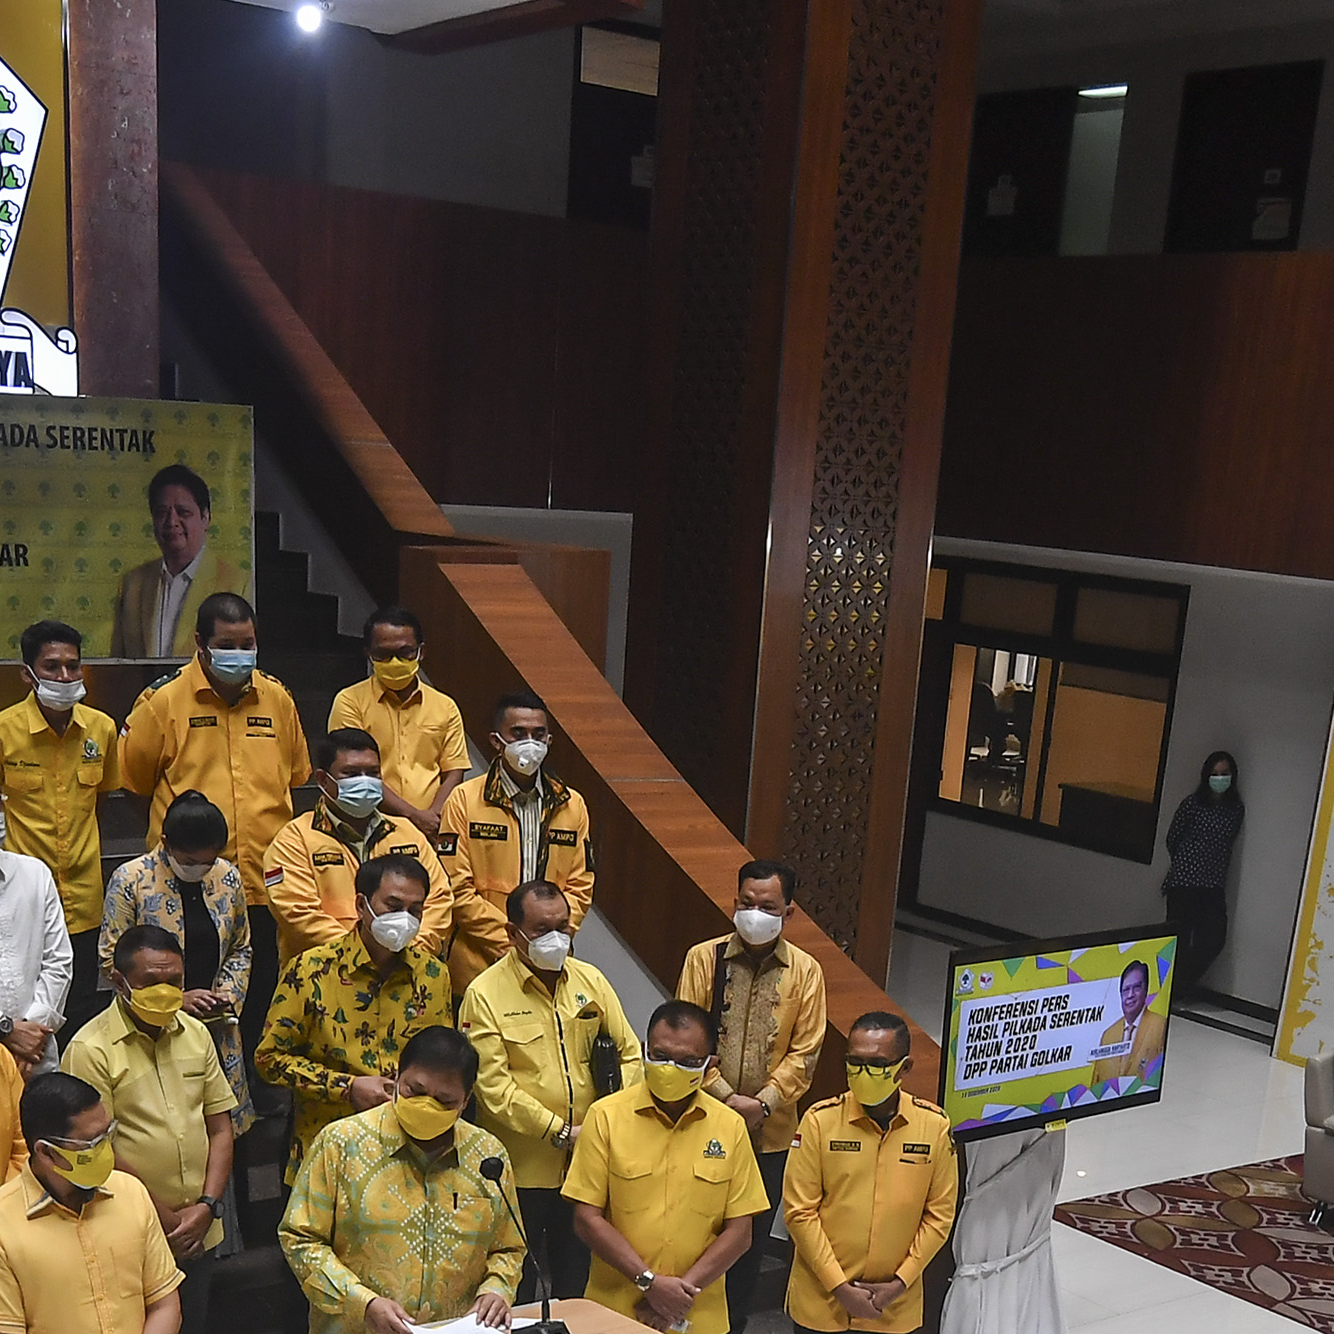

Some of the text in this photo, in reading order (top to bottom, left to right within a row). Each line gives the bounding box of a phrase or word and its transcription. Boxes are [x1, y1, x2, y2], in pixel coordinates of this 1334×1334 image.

[45, 425, 156, 453] SERENTAK
[966, 1005, 1105, 1044] HASIL PILKADA SERENTAK
[968, 994, 1070, 1026] KONFERENSI PERS
[963, 1045, 1072, 1081] DPP PARTAI GOLKAR
[965, 1034, 1037, 1062] TAHUN 2020
